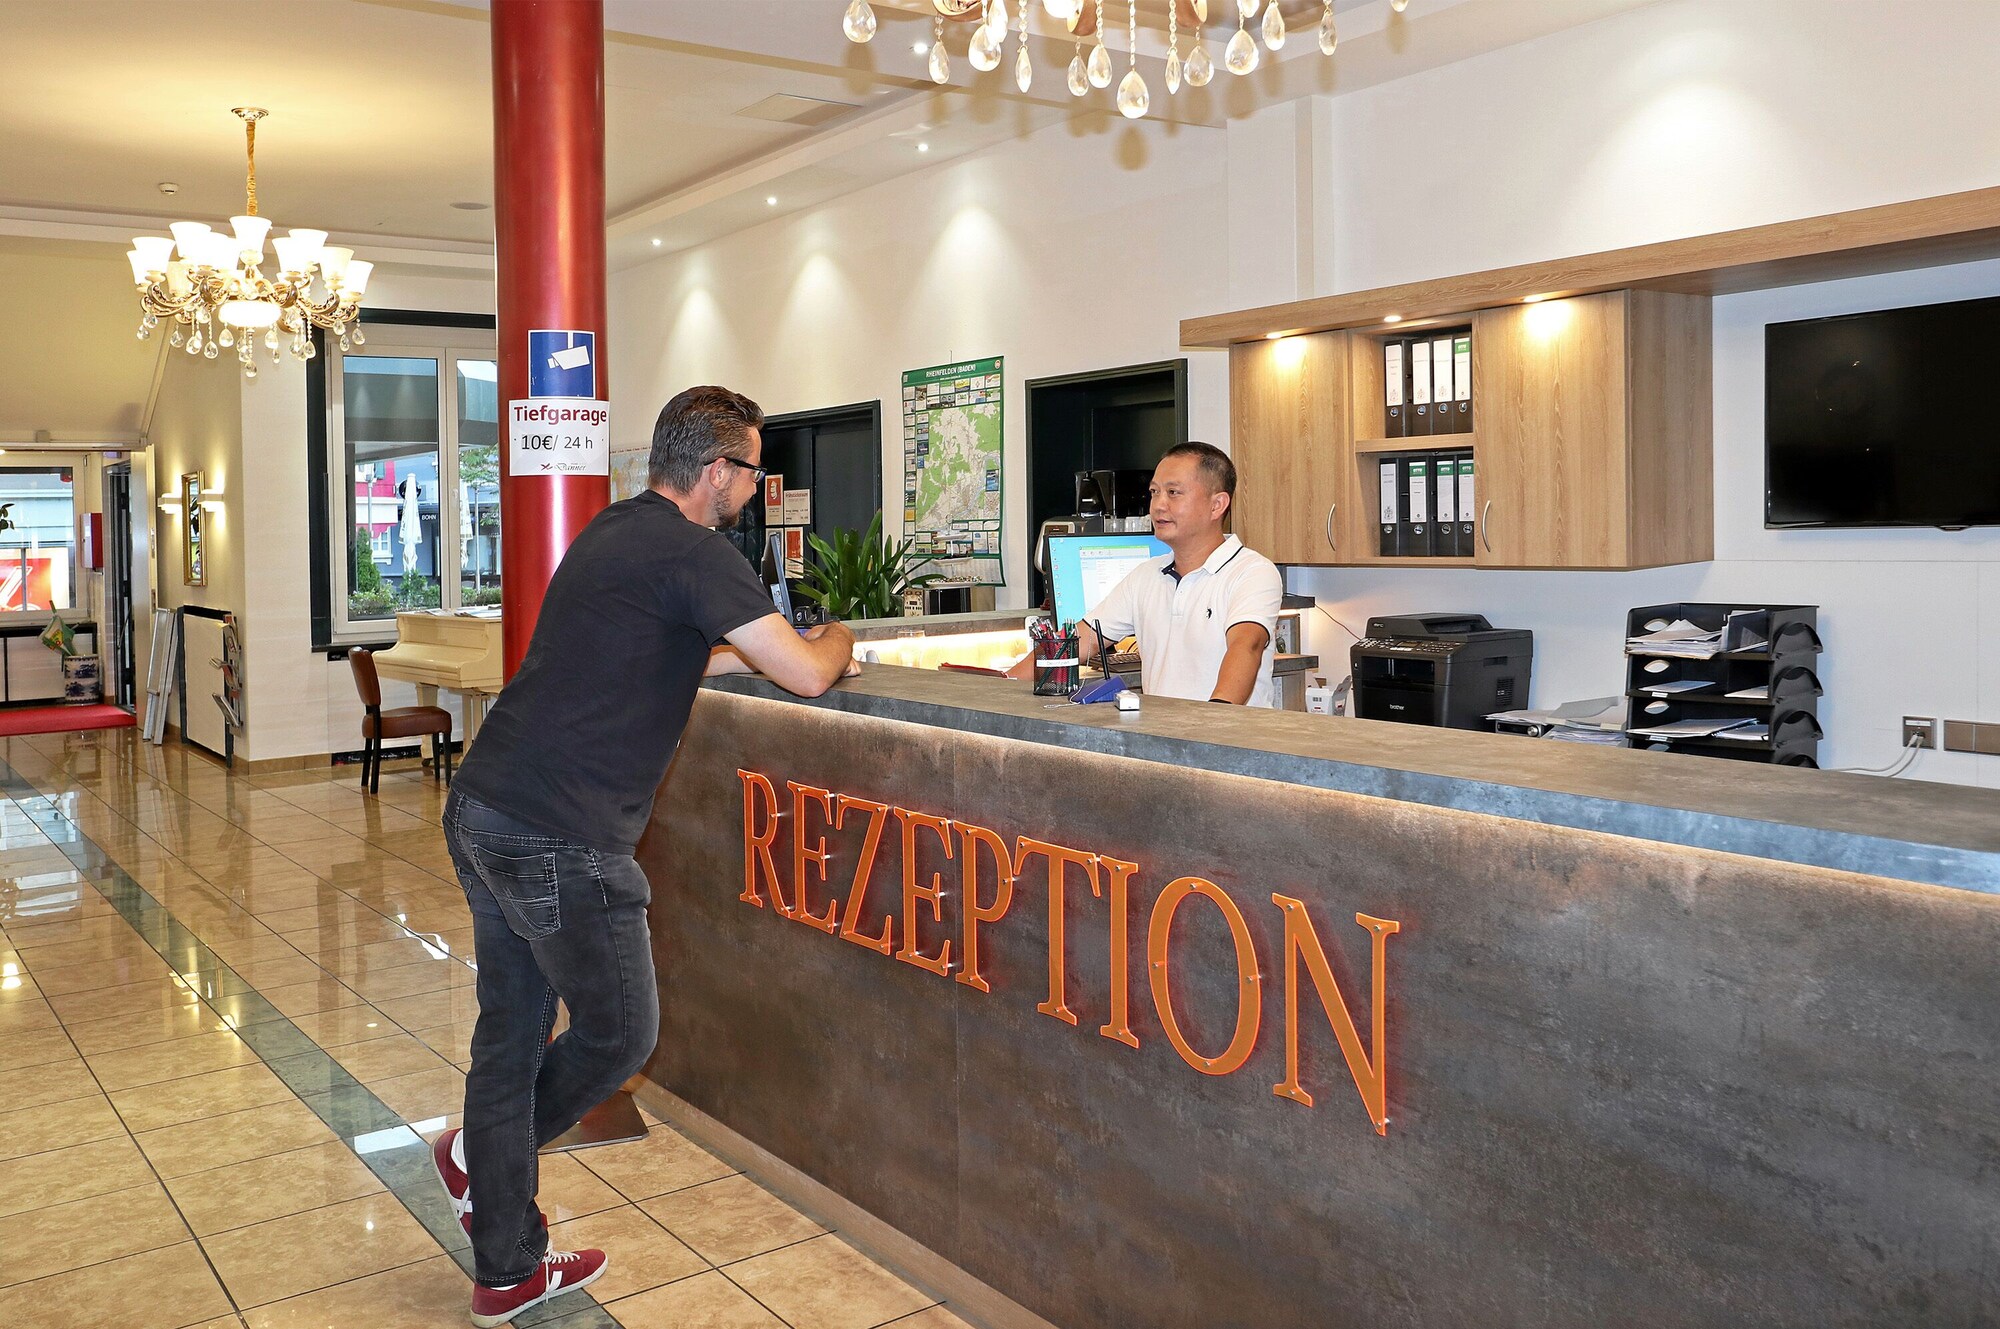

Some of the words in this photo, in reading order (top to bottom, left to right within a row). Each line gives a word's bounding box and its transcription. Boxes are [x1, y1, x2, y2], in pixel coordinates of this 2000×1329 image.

[926, 366, 957, 378] RHEINFELDEN
[957, 363, 976, 375] (BADEN)
[514, 405, 607, 426] Tiefgarage
[564, 436, 581, 449] 24
[586, 436, 593, 449] h
[737, 767, 1400, 1137] REZEPTION
